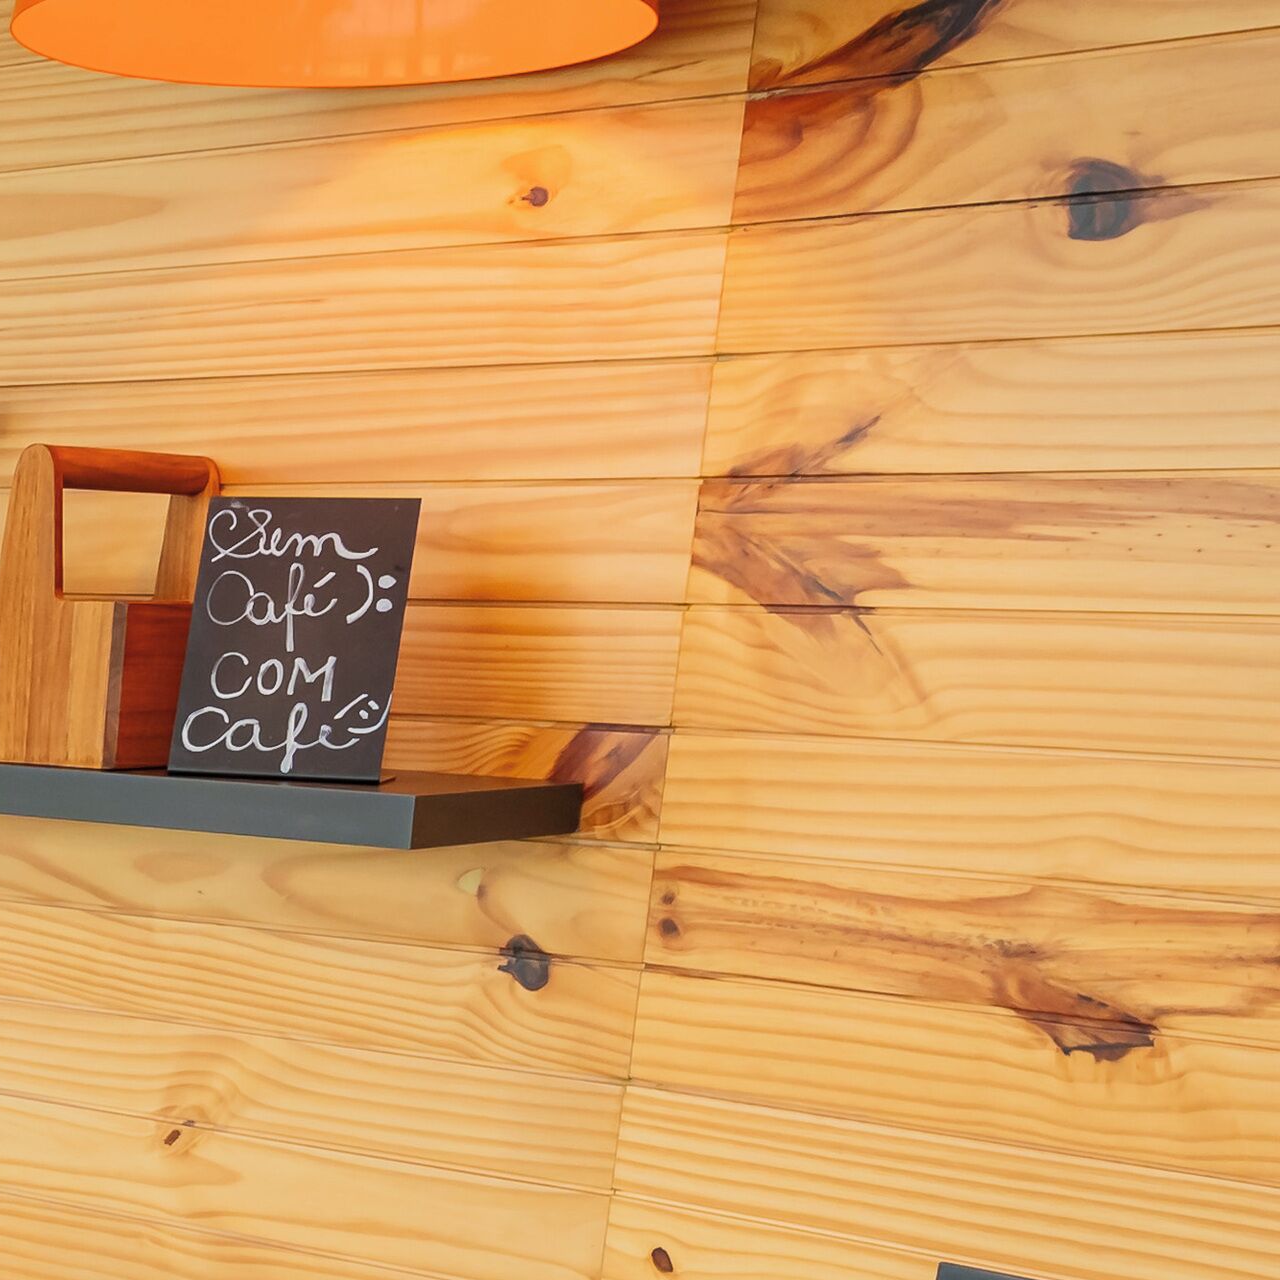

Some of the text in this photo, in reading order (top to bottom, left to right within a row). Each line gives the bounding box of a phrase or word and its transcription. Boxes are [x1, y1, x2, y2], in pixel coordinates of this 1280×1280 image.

[208, 508, 378, 563] Sem
[206, 562, 338, 652] Café
[210, 652, 337, 702] COM
[181, 693, 369, 774] Café
